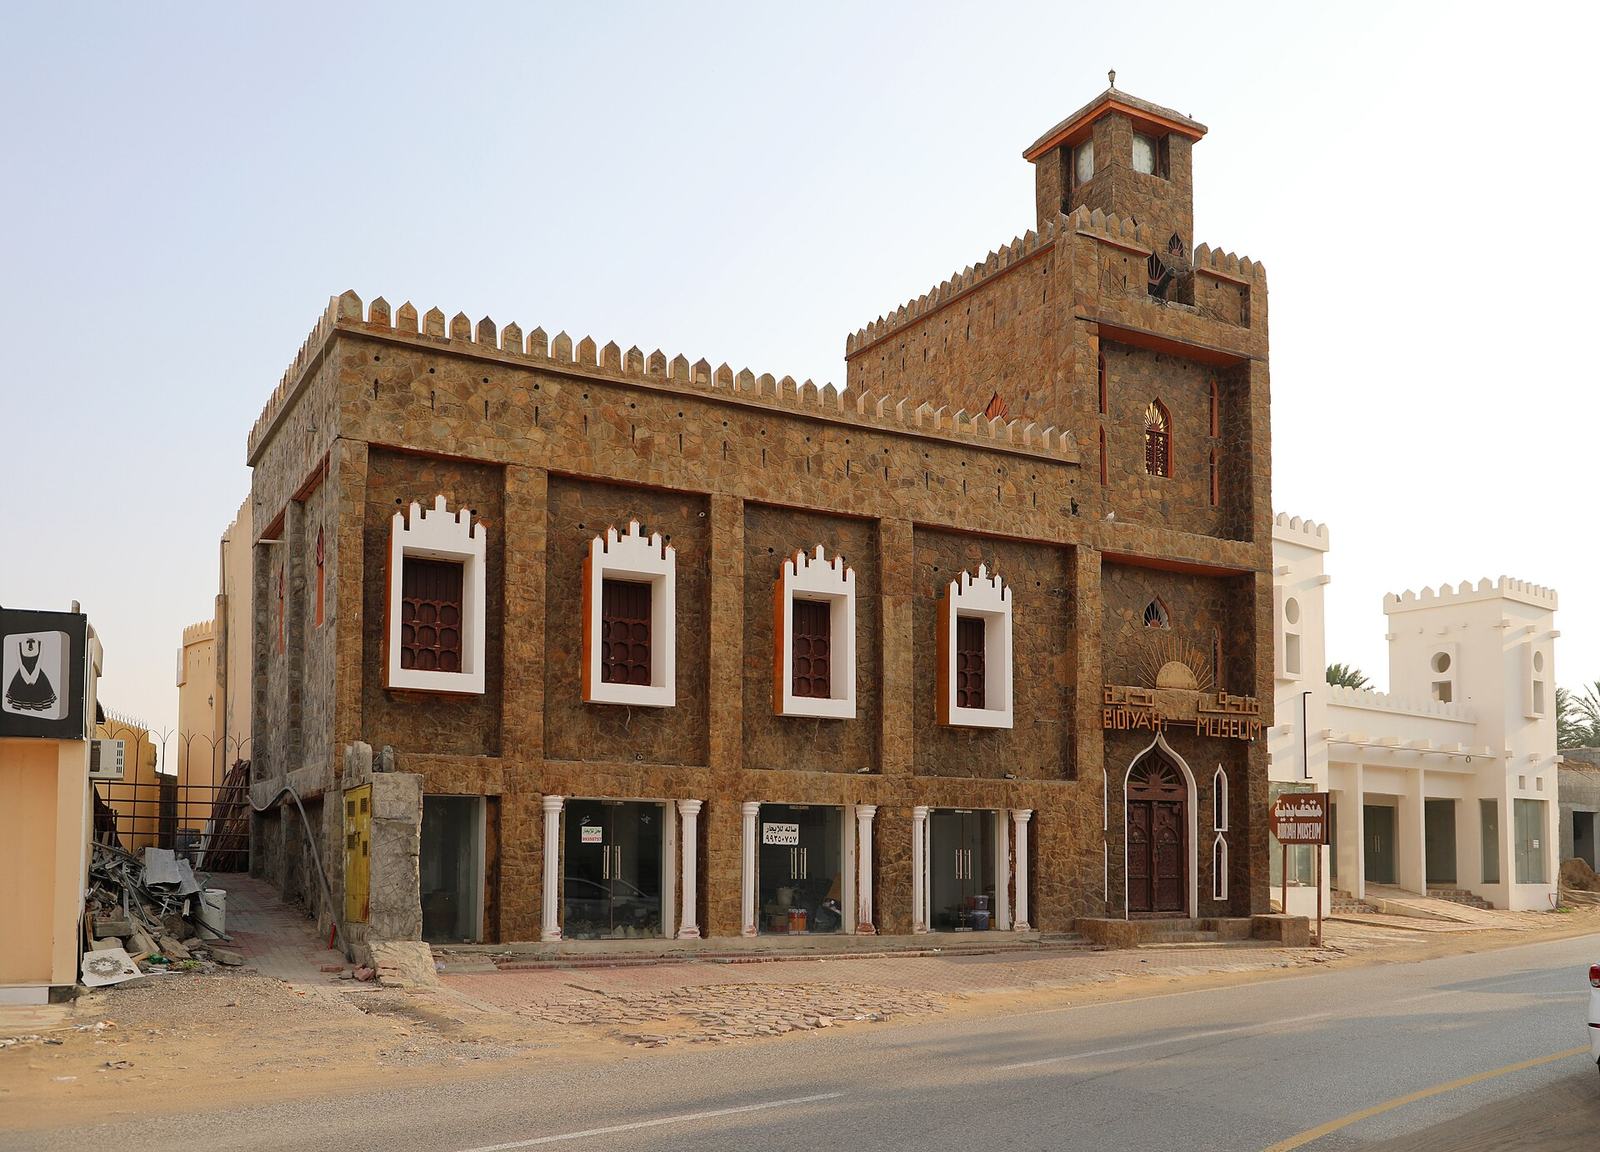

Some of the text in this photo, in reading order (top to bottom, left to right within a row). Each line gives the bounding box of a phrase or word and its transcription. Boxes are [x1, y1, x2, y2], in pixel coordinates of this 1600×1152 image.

[1104, 708, 1262, 741] BIDIYAH MUSEUM
[1274, 798, 1323, 822] متحف بدية
[1297, 822, 1322, 839] MUSEUM
